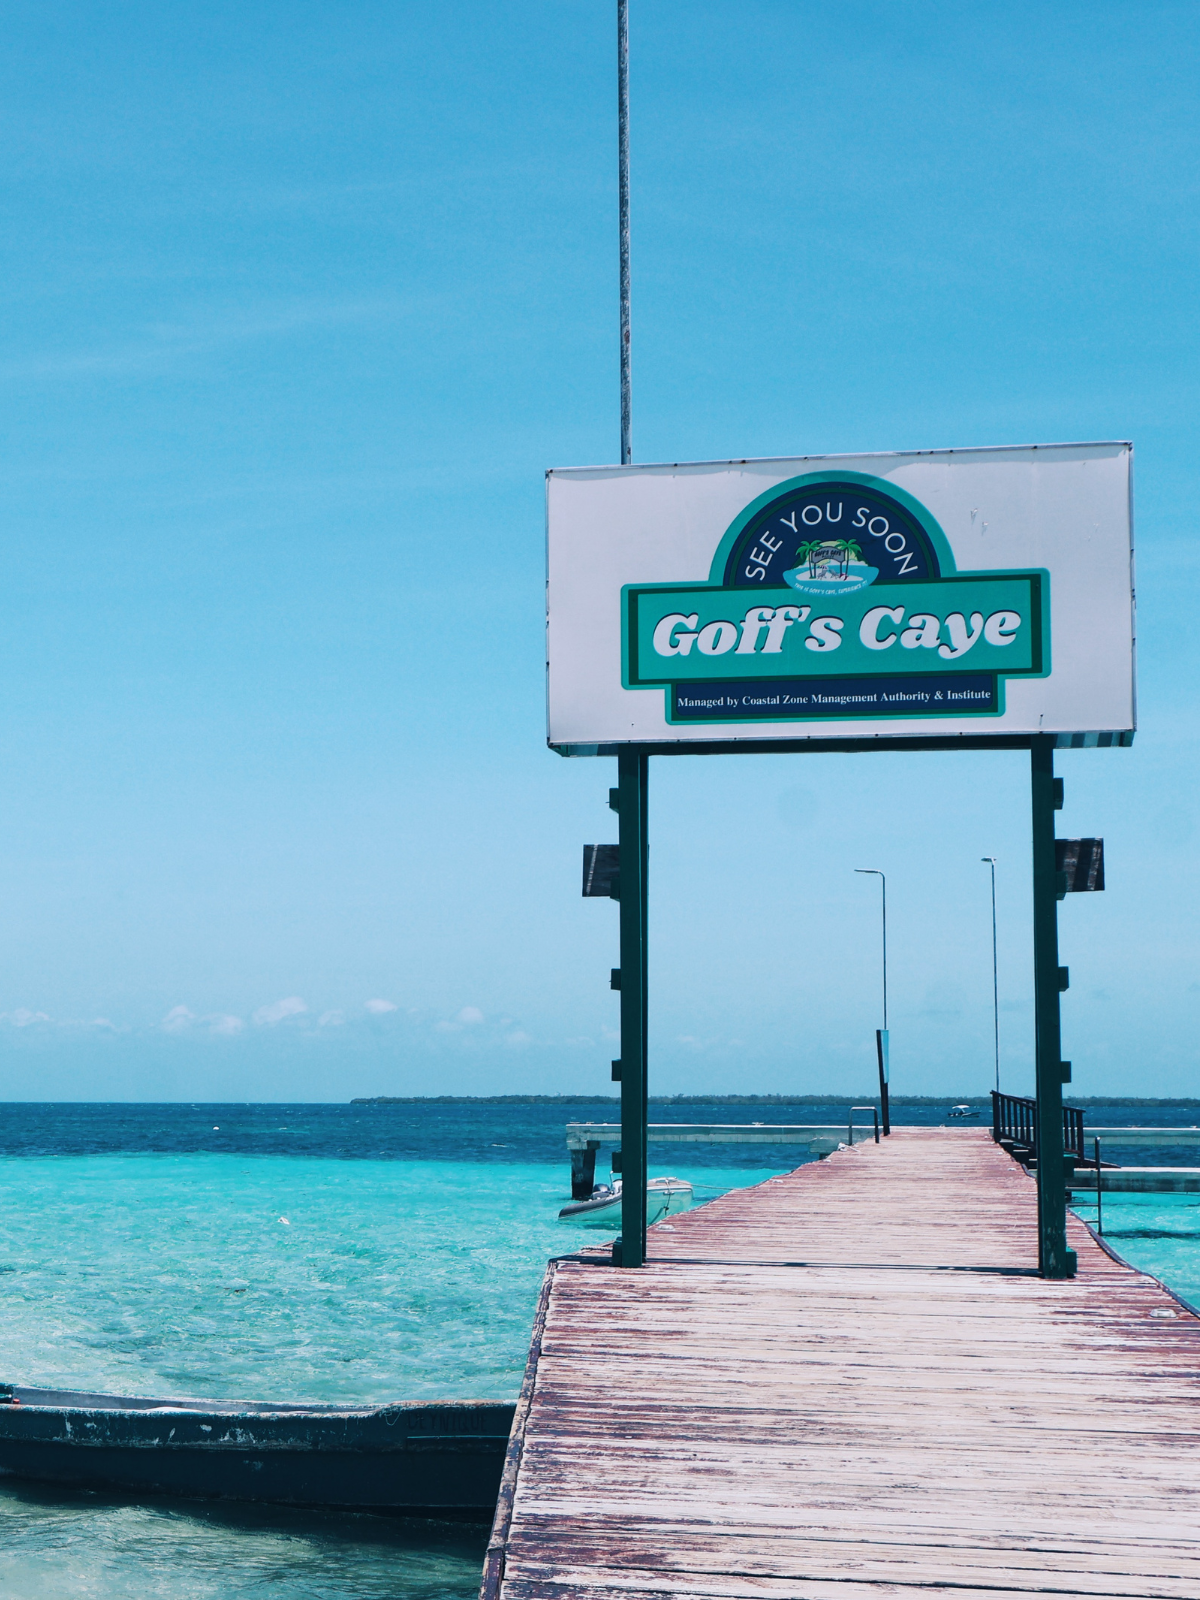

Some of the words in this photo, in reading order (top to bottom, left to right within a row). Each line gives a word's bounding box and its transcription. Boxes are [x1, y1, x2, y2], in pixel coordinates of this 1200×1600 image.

[745, 530, 783, 581] SEE
[780, 502, 843, 533] YOU
[852, 507, 918, 575] SOON
[652, 604, 844, 657] Goff's
[858, 604, 1022, 660] Caye
[677, 696, 724, 708] Managed
[727, 696, 739, 707] by
[742, 695, 780, 705] Coastal
[782, 694, 808, 704] Zone
[811, 693, 878, 705] Management
[880, 691, 931, 702] Authority
[934, 690, 944, 700] &
[947, 689, 991, 700] Institute
